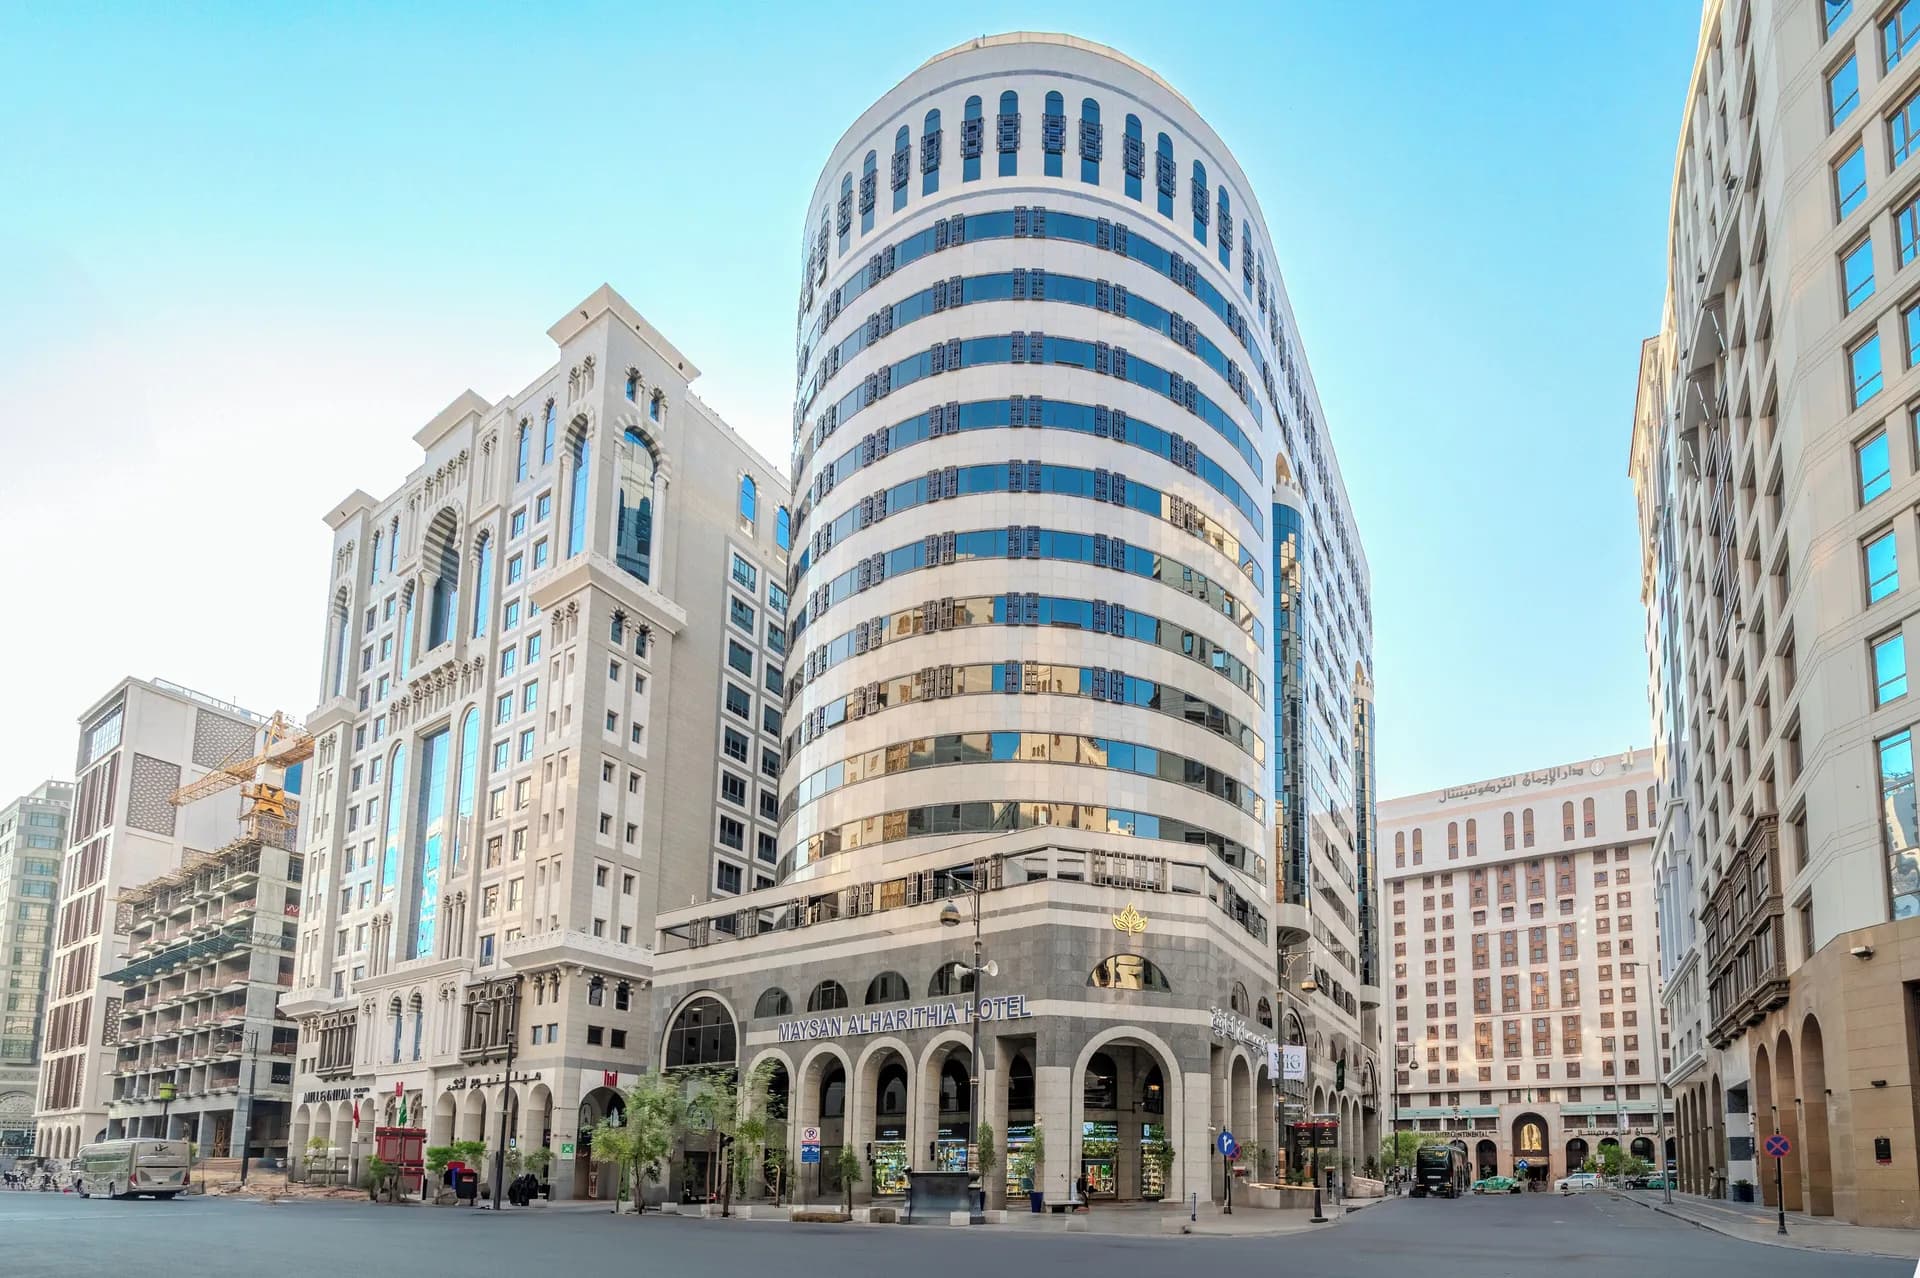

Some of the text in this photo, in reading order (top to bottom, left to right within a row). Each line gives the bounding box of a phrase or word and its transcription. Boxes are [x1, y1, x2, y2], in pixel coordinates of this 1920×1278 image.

[778, 994, 1033, 1042] MAYSAN ALHARITHIA HOTEL
